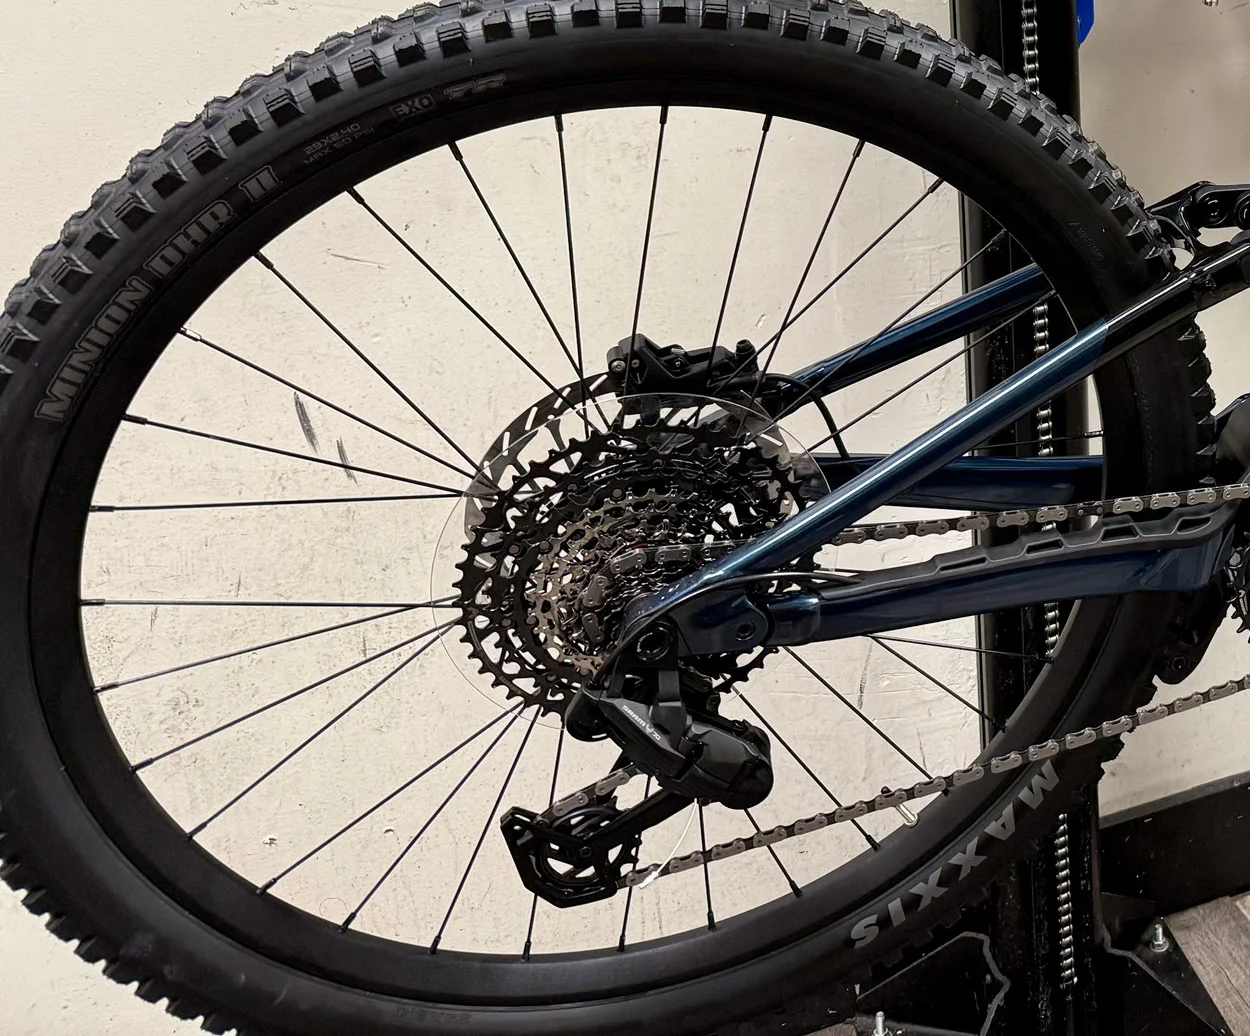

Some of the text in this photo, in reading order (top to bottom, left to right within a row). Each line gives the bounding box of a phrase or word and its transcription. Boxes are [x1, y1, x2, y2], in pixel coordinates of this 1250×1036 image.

[394, 94, 434, 116] EXO
[34, 275, 154, 422] MINION
[143, 199, 234, 278] DHR
[849, 760, 1060, 950] MAXXIS
